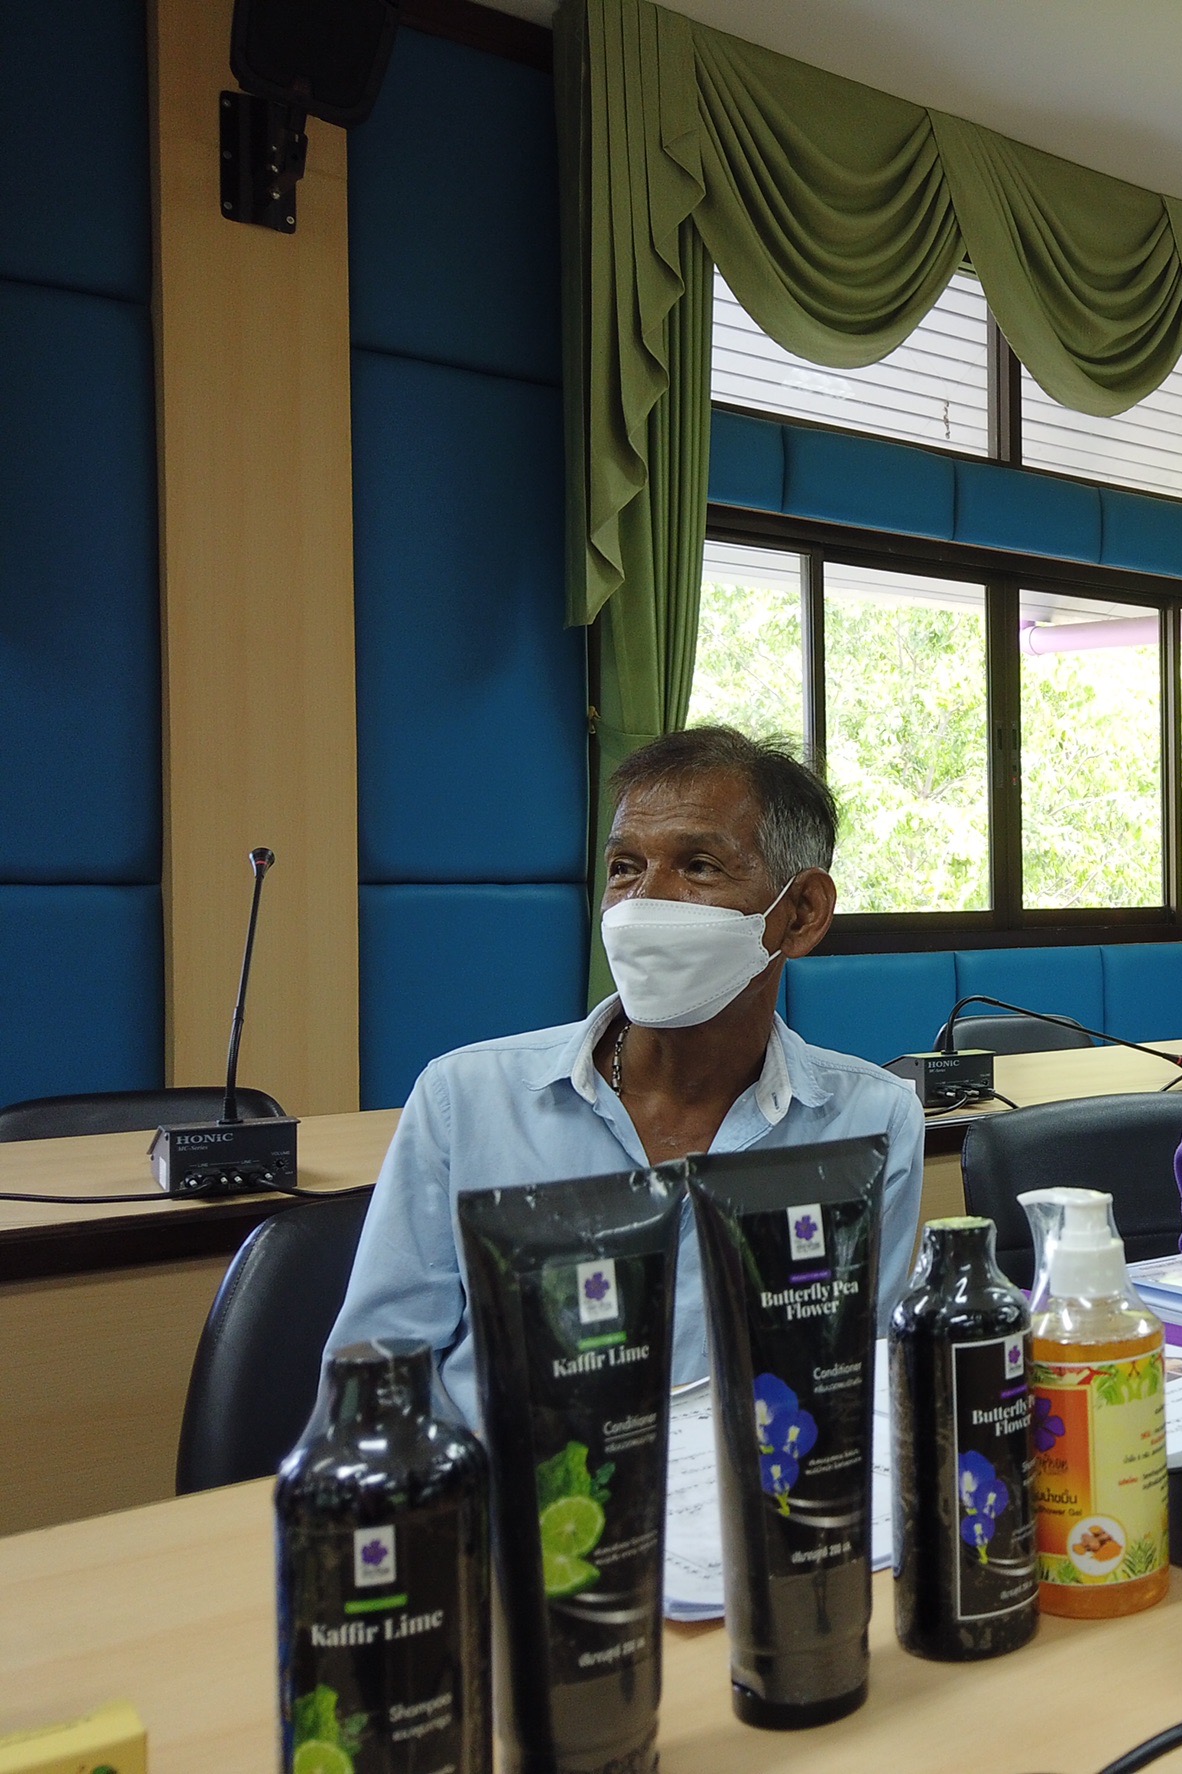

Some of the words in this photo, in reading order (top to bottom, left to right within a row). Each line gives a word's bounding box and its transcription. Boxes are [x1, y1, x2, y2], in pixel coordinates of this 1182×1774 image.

[176, 1133, 234, 1145] HONiC
[760, 1282, 831, 1308] Butterfly
[832, 1280, 859, 1298] Pea
[786, 1299, 840, 1321] Flower
[552, 1350, 605, 1378] Kaffir
[608, 1343, 650, 1366] Lime
[813, 1360, 862, 1381] Conditioner
[972, 1396, 1027, 1425] Butterfly
[603, 1412, 657, 1436] Conditioner
[995, 1413, 1031, 1437] Flower
[311, 1620, 380, 1647] Kaffir
[384, 1609, 444, 1640] Lime
